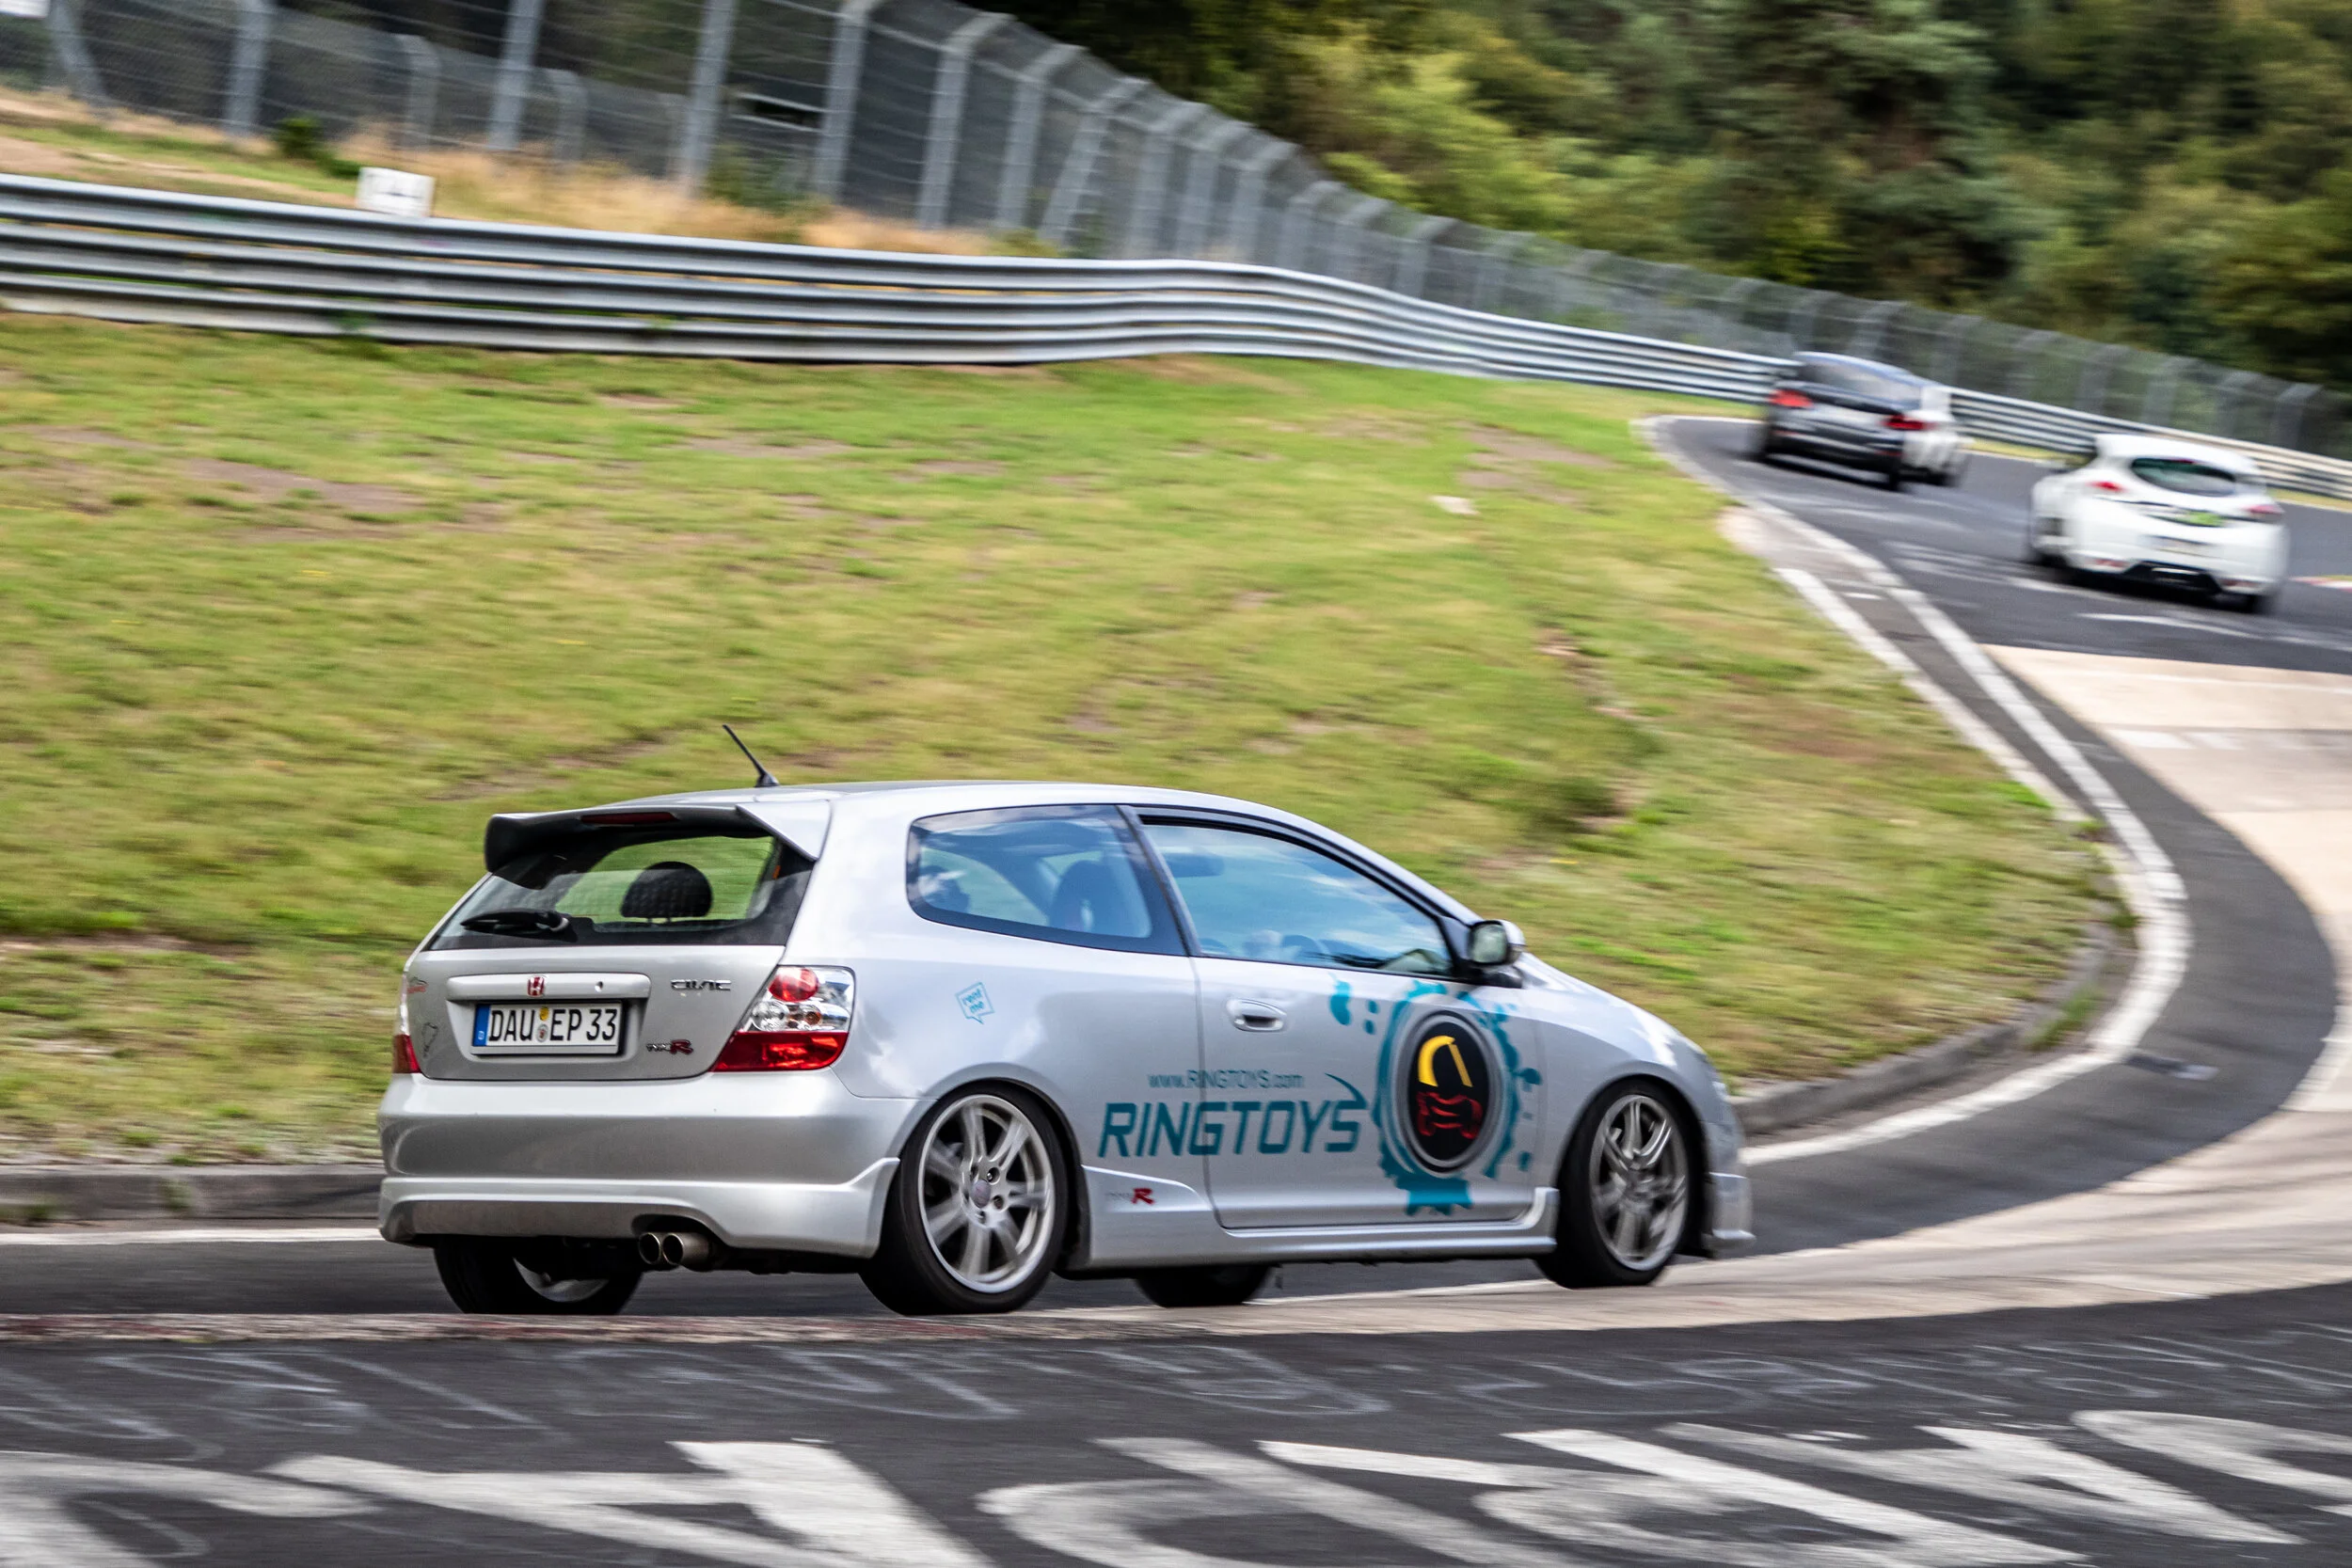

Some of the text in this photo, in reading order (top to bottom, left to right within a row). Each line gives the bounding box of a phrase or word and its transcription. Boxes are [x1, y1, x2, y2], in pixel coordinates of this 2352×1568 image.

[488, 1008, 618, 1042] DAU EP 33
[1098, 1094, 1368, 1159] RINGTOYS
